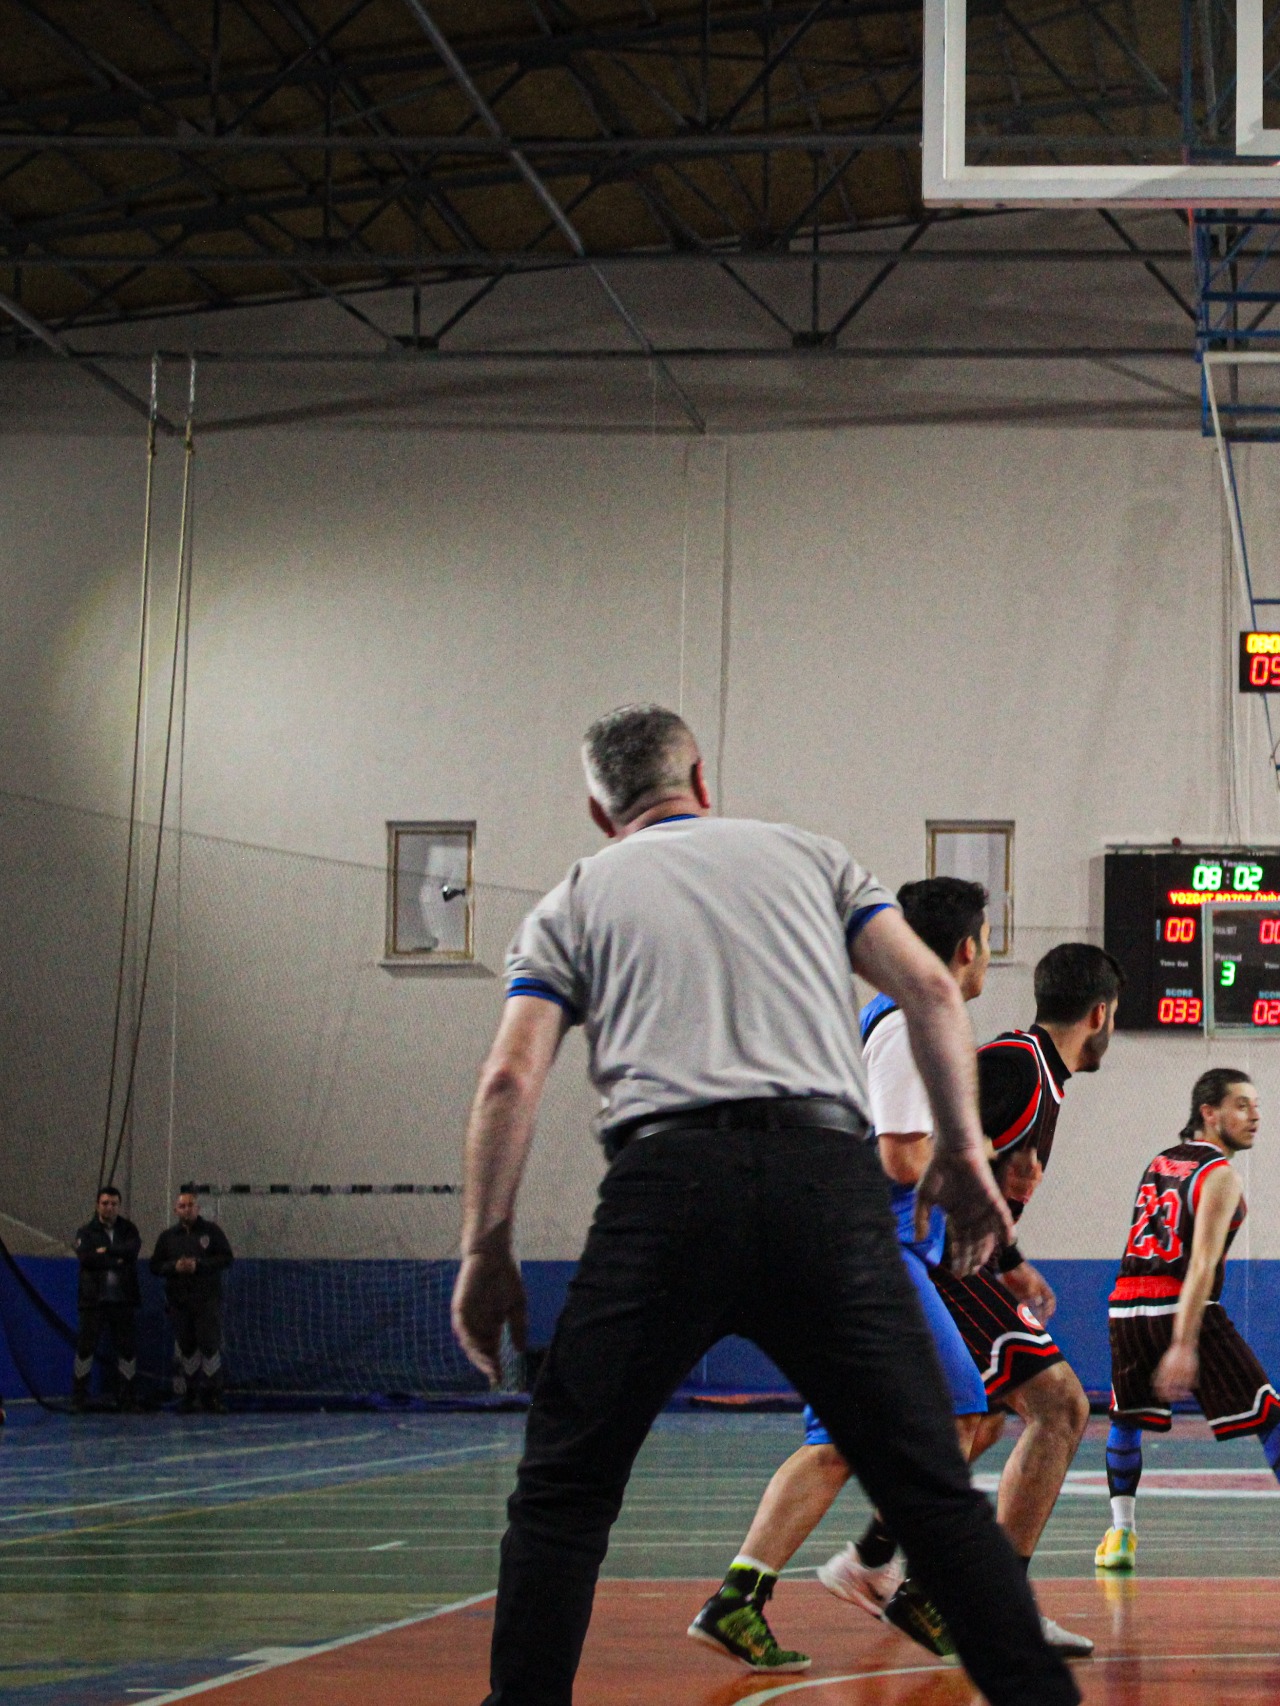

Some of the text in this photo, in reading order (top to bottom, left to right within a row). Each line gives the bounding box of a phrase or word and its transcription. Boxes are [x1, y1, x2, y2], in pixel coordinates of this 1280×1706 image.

[1170, 892, 1213, 905] YOZGAT
[1165, 916, 1196, 944] 00
[1220, 961, 1236, 987] 3
[1166, 988, 1193, 998] SCORE
[1158, 998, 1203, 1024] 033
[1126, 1183, 1184, 1264] 23
